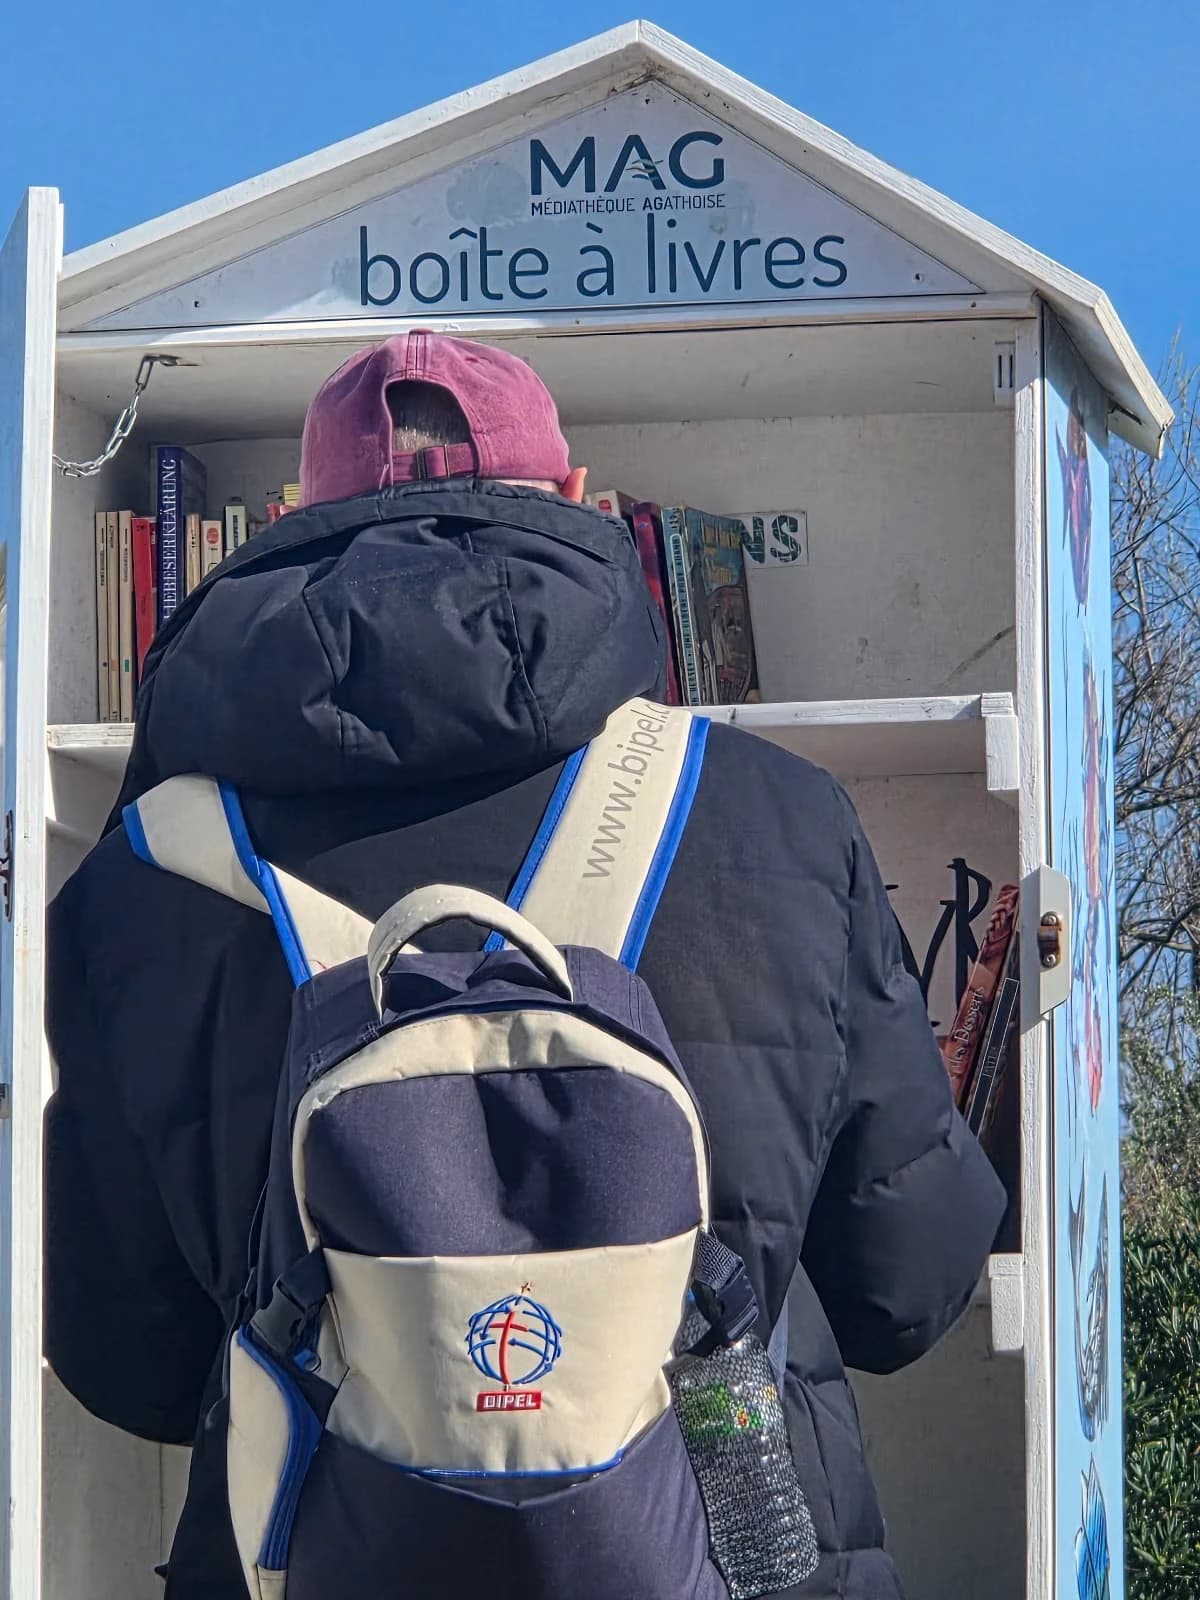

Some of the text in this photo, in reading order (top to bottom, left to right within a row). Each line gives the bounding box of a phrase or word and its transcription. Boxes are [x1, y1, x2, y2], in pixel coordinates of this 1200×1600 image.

[530, 131, 725, 195] MAG
[531, 194, 726, 216] MÉDIATHÈQUE AGATHOISE
[360, 212, 848, 306] boîte à livres
